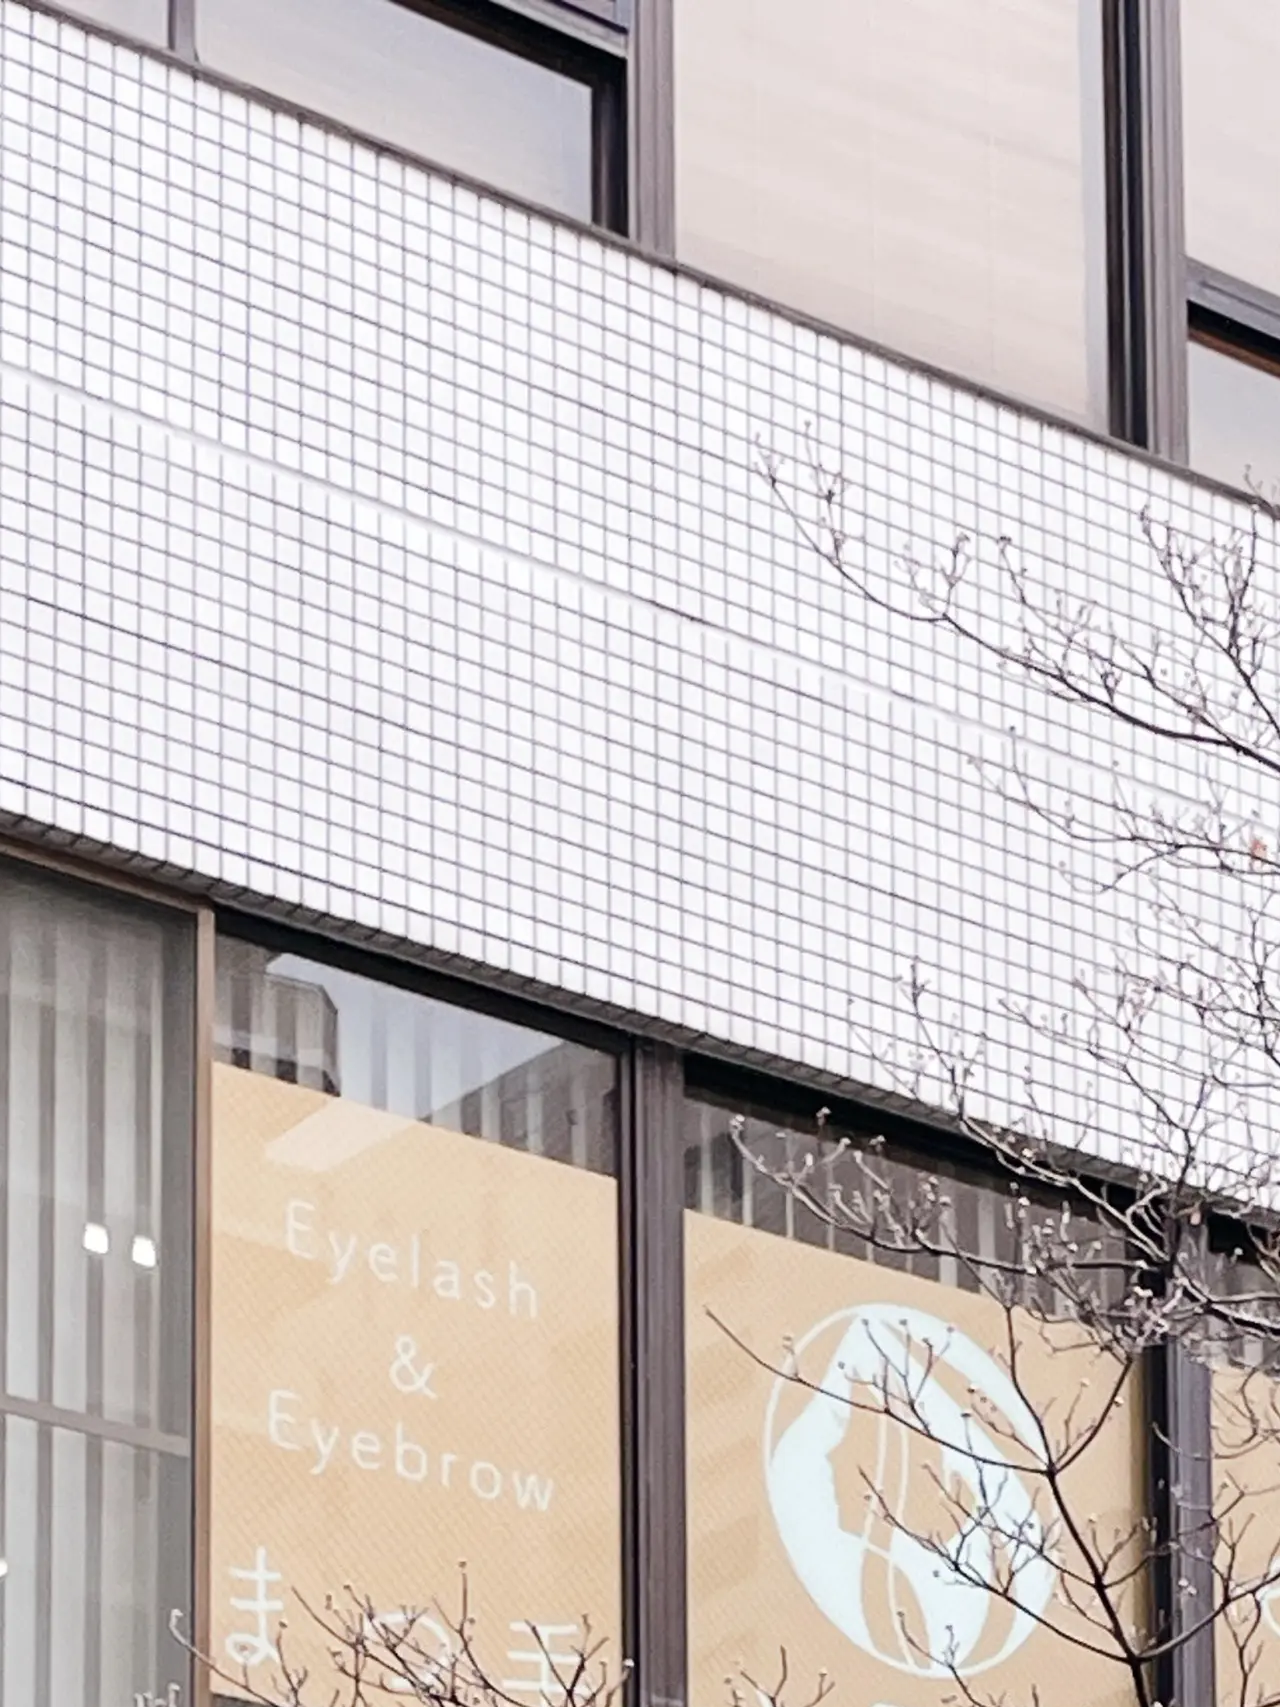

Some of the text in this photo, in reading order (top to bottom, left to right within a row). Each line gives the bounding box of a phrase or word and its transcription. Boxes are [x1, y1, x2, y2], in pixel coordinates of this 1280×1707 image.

[285, 1201, 538, 1319] Eyelash
[389, 1336, 438, 1398] &
[267, 1389, 554, 1512] Eyebrow
